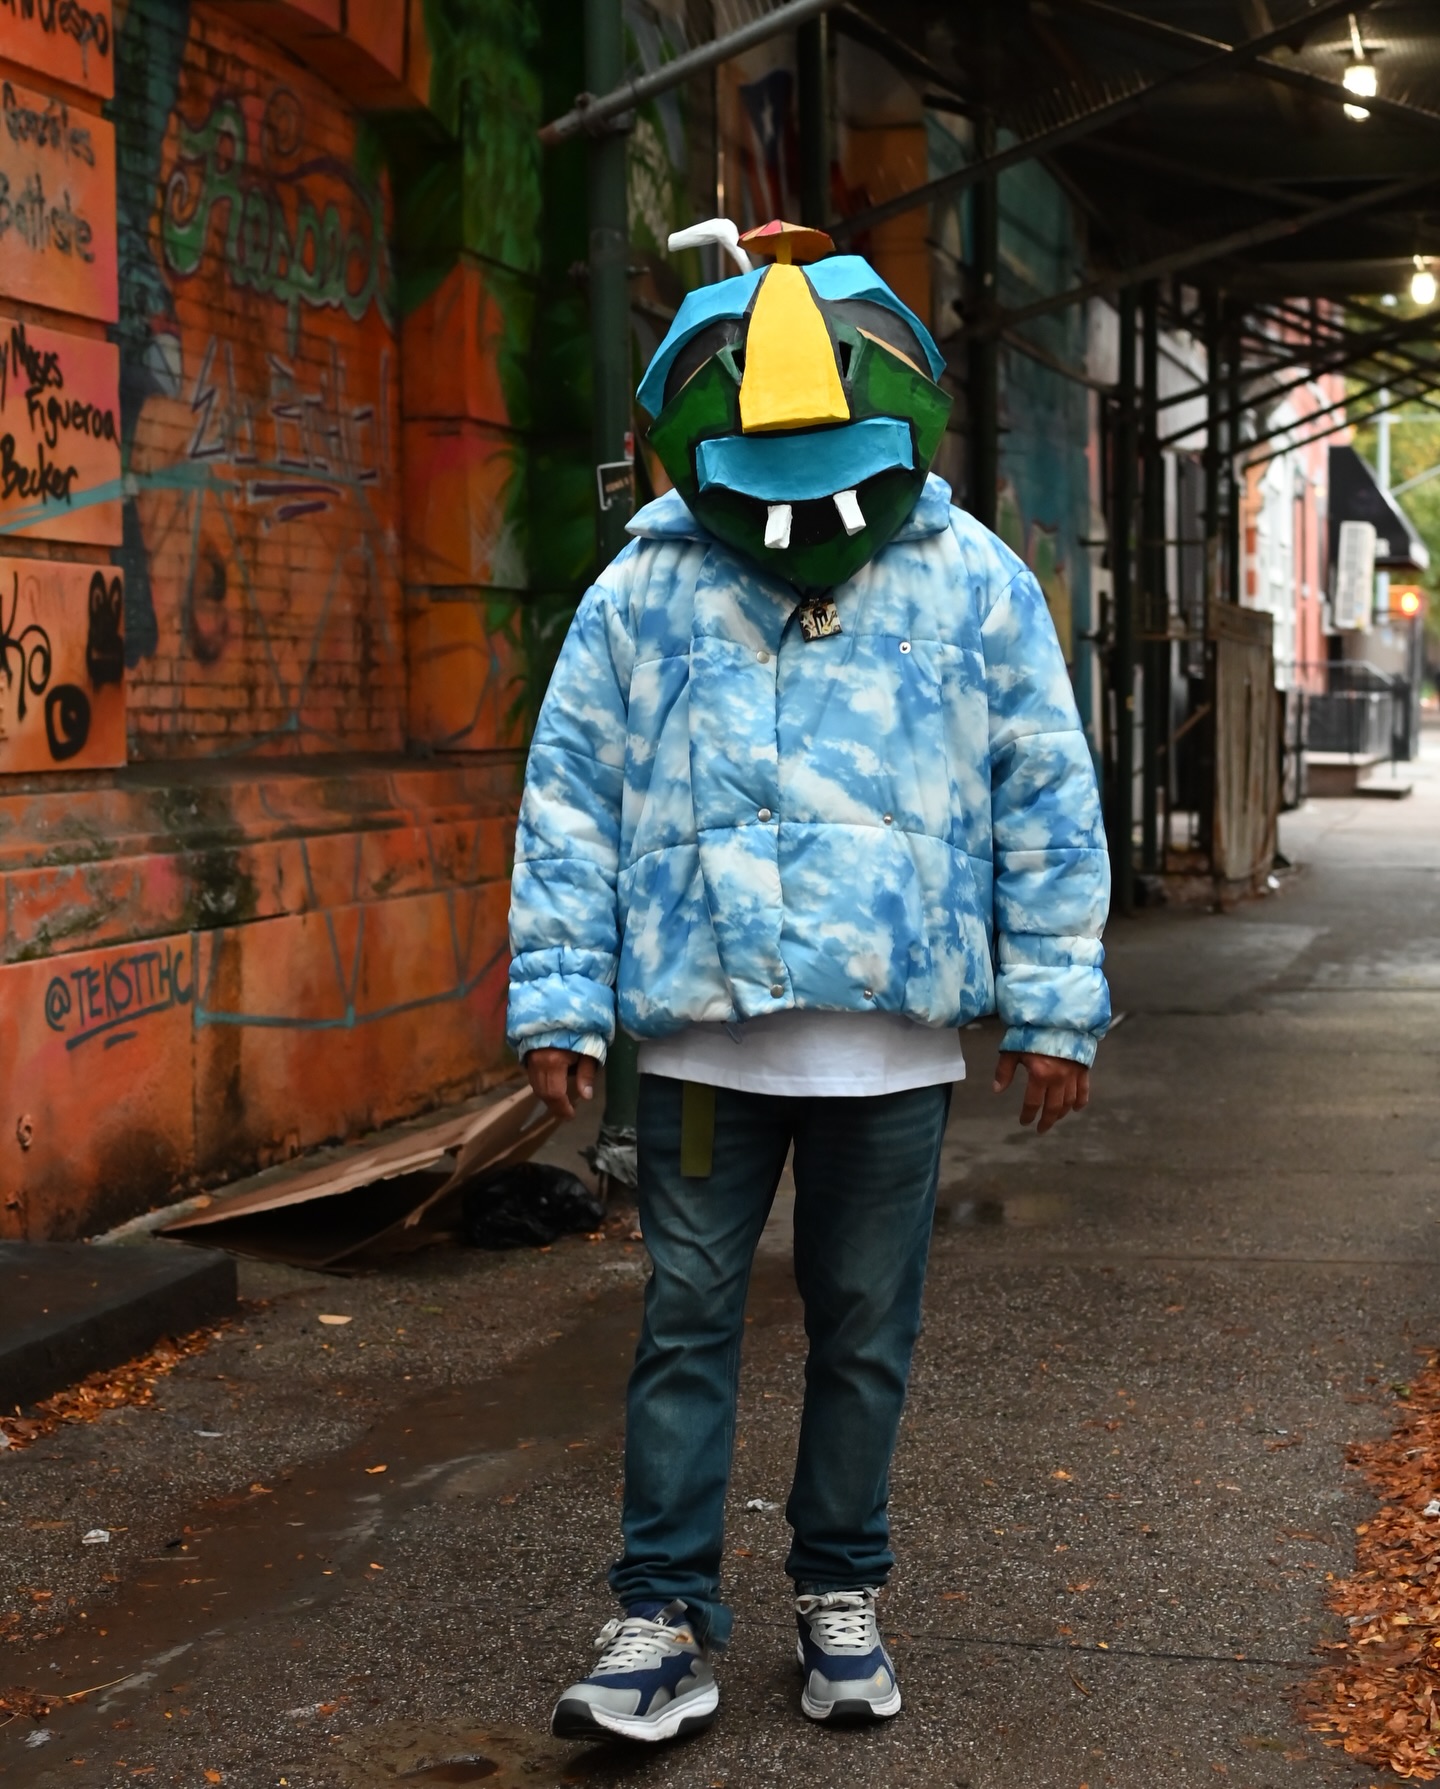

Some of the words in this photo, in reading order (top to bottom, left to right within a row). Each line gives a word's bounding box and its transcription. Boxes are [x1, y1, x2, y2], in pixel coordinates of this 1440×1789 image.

[11, 322, 63, 389] Moses
[25, 385, 121, 450] Figueroa
[1, 433, 78, 507] Becker
